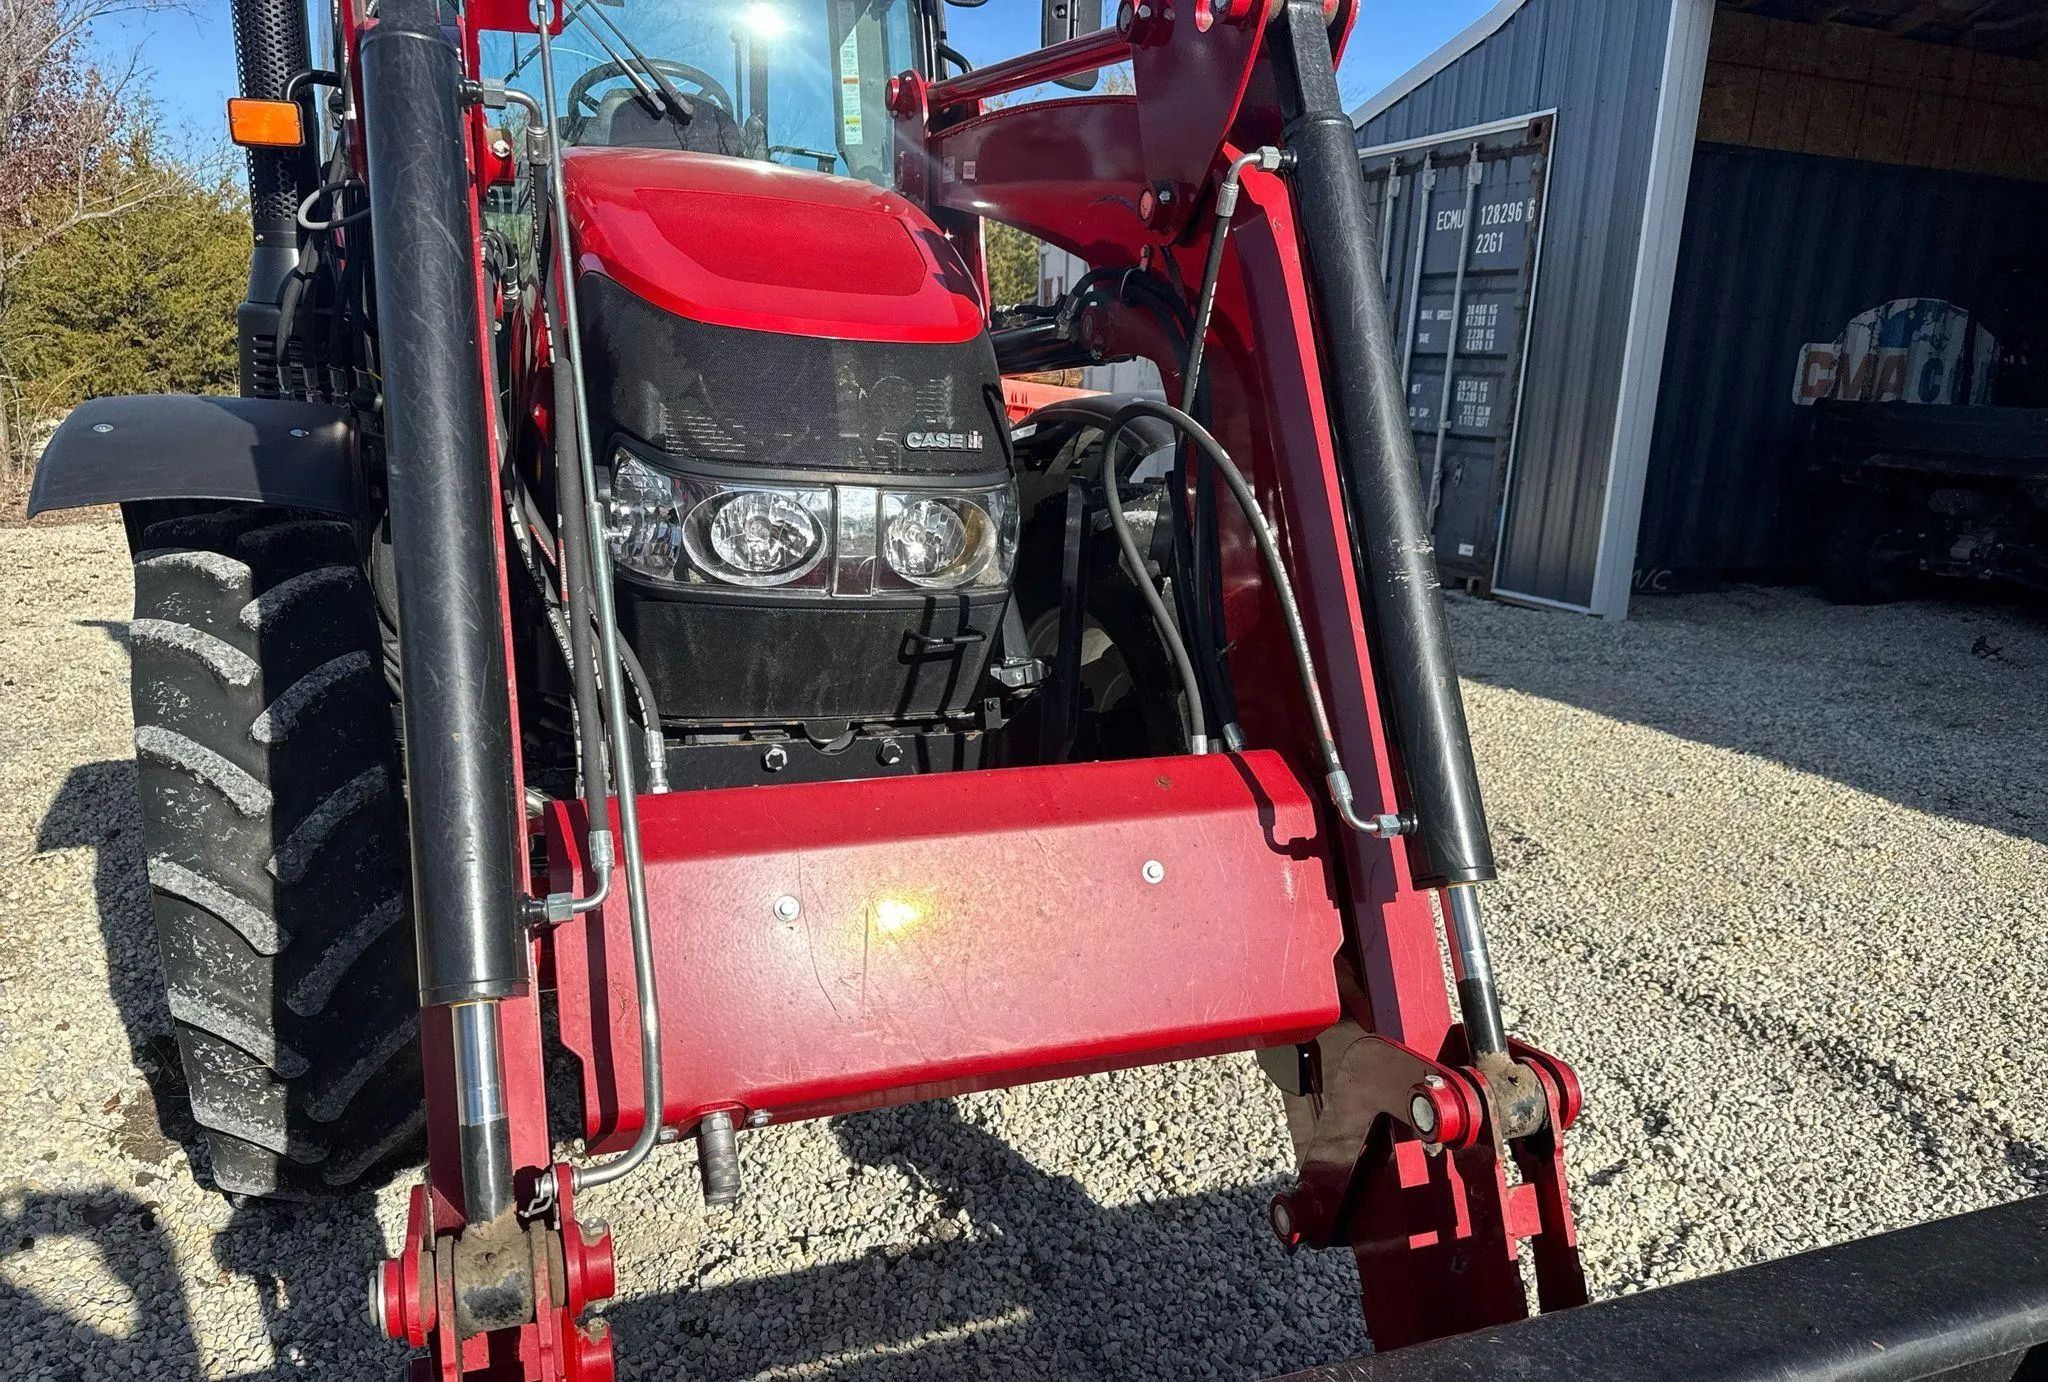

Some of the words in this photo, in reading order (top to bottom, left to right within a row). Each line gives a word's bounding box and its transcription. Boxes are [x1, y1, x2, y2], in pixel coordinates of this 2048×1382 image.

[1436, 209, 1466, 231] ECMU
[1481, 201, 1523, 226] 128296
[1528, 198, 1536, 221] 6
[1475, 232, 1504, 254] 22G1
[1801, 351, 1906, 400] CMA
[906, 431, 964, 449] CASE
